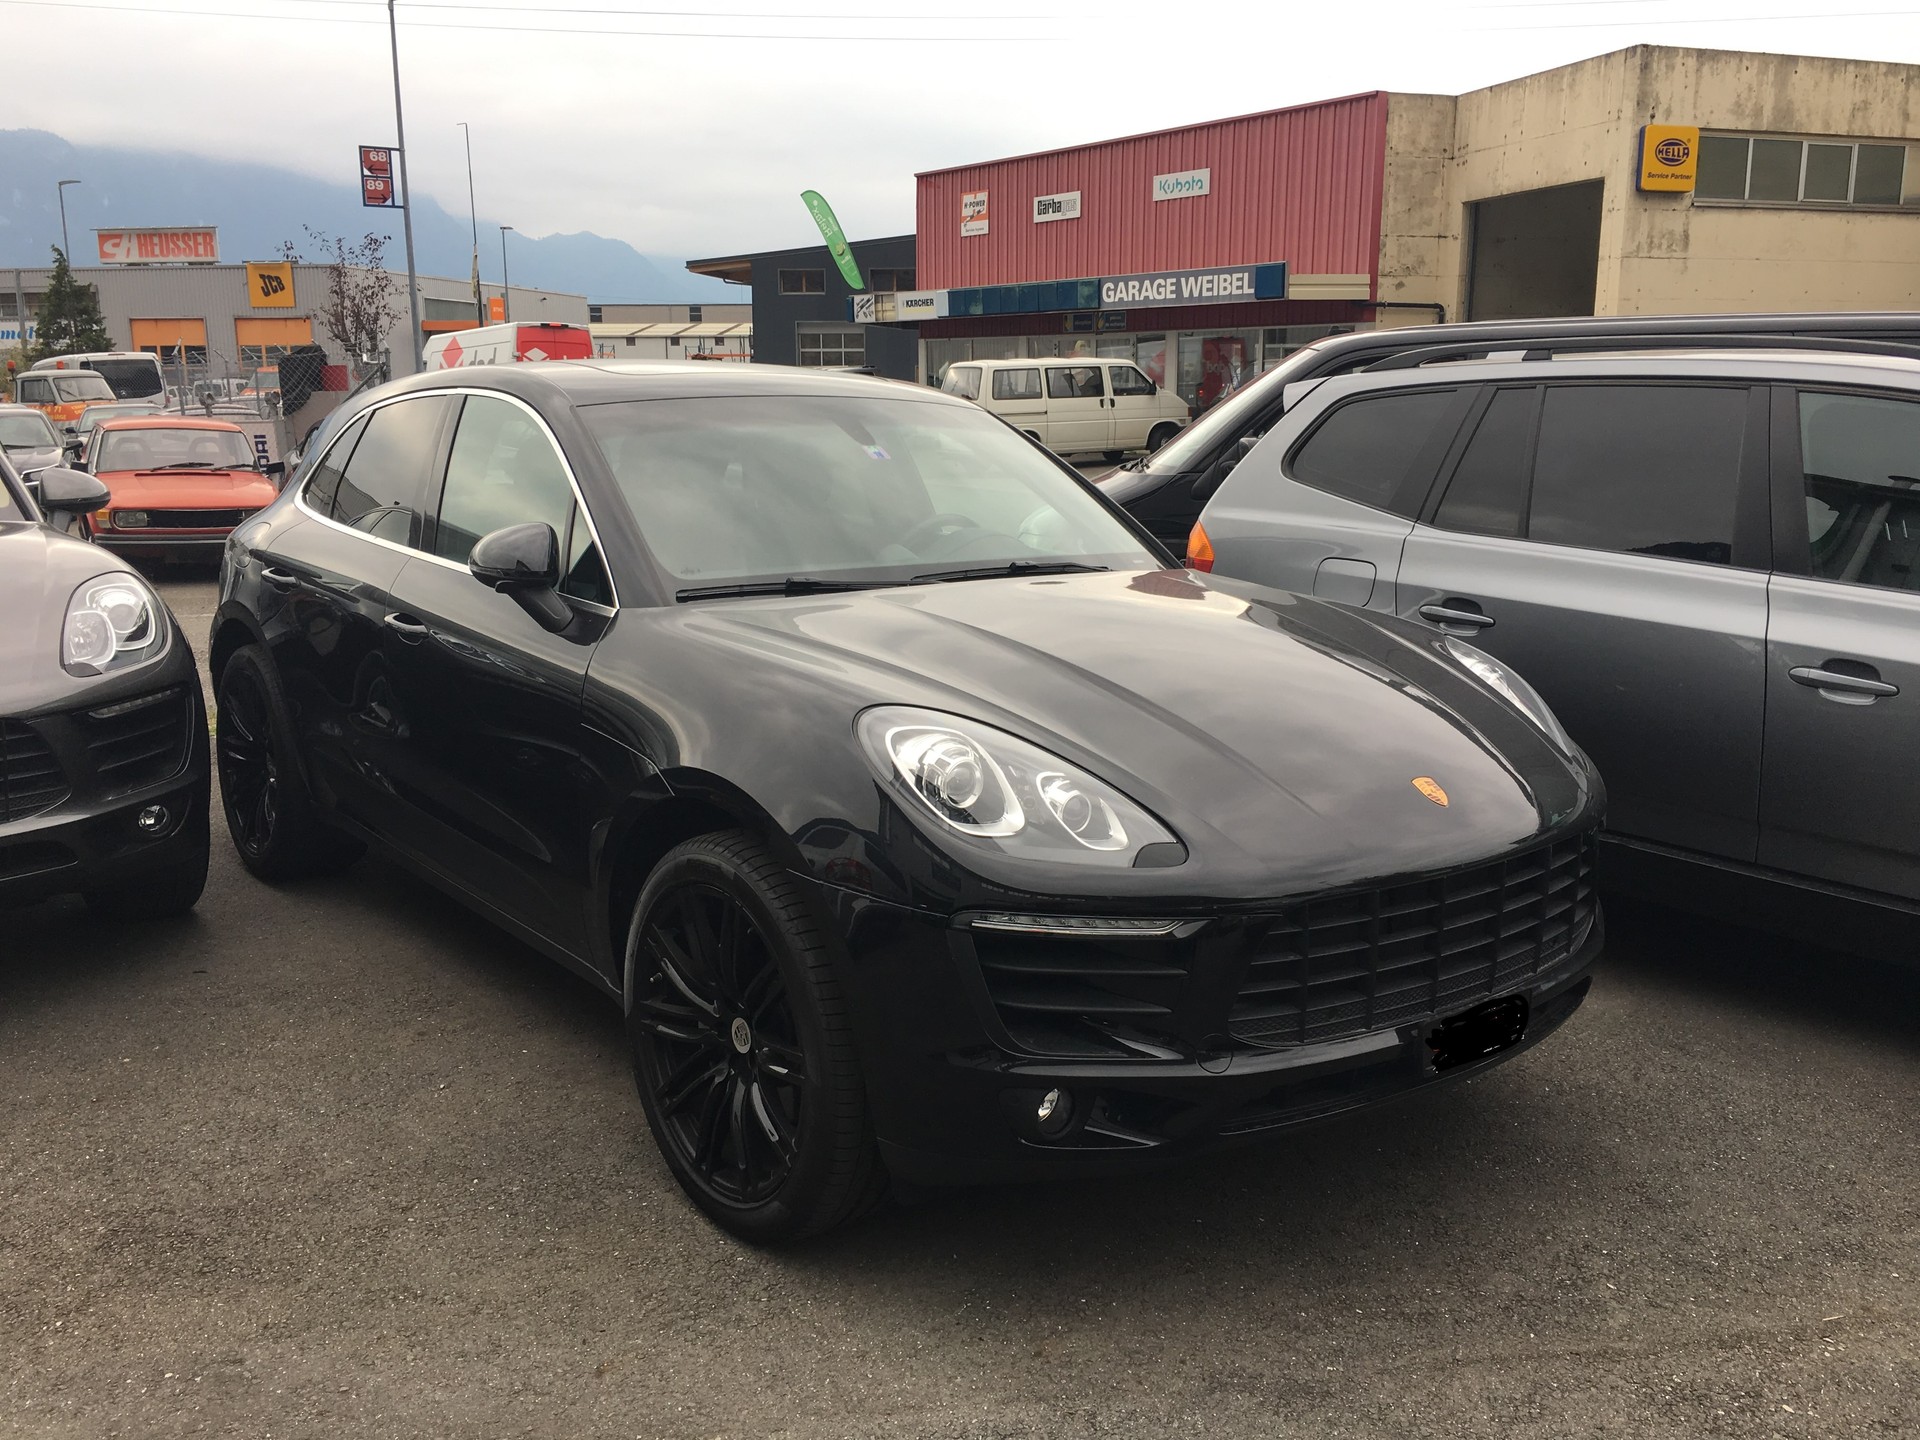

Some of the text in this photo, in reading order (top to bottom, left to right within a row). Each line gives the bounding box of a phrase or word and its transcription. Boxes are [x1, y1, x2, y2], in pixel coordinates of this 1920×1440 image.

[369, 151, 387, 162] 68
[1658, 147, 1690, 159] HELLA
[366, 180, 384, 191] 89
[1159, 175, 1204, 195] Kubota
[1647, 171, 1692, 180] Service Partner
[136, 232, 215, 259] HEUSSER
[258, 273, 286, 298] JCB
[1102, 272, 1255, 303] GARAGE WEIBEL
[253, 434, 270, 472] DAI
